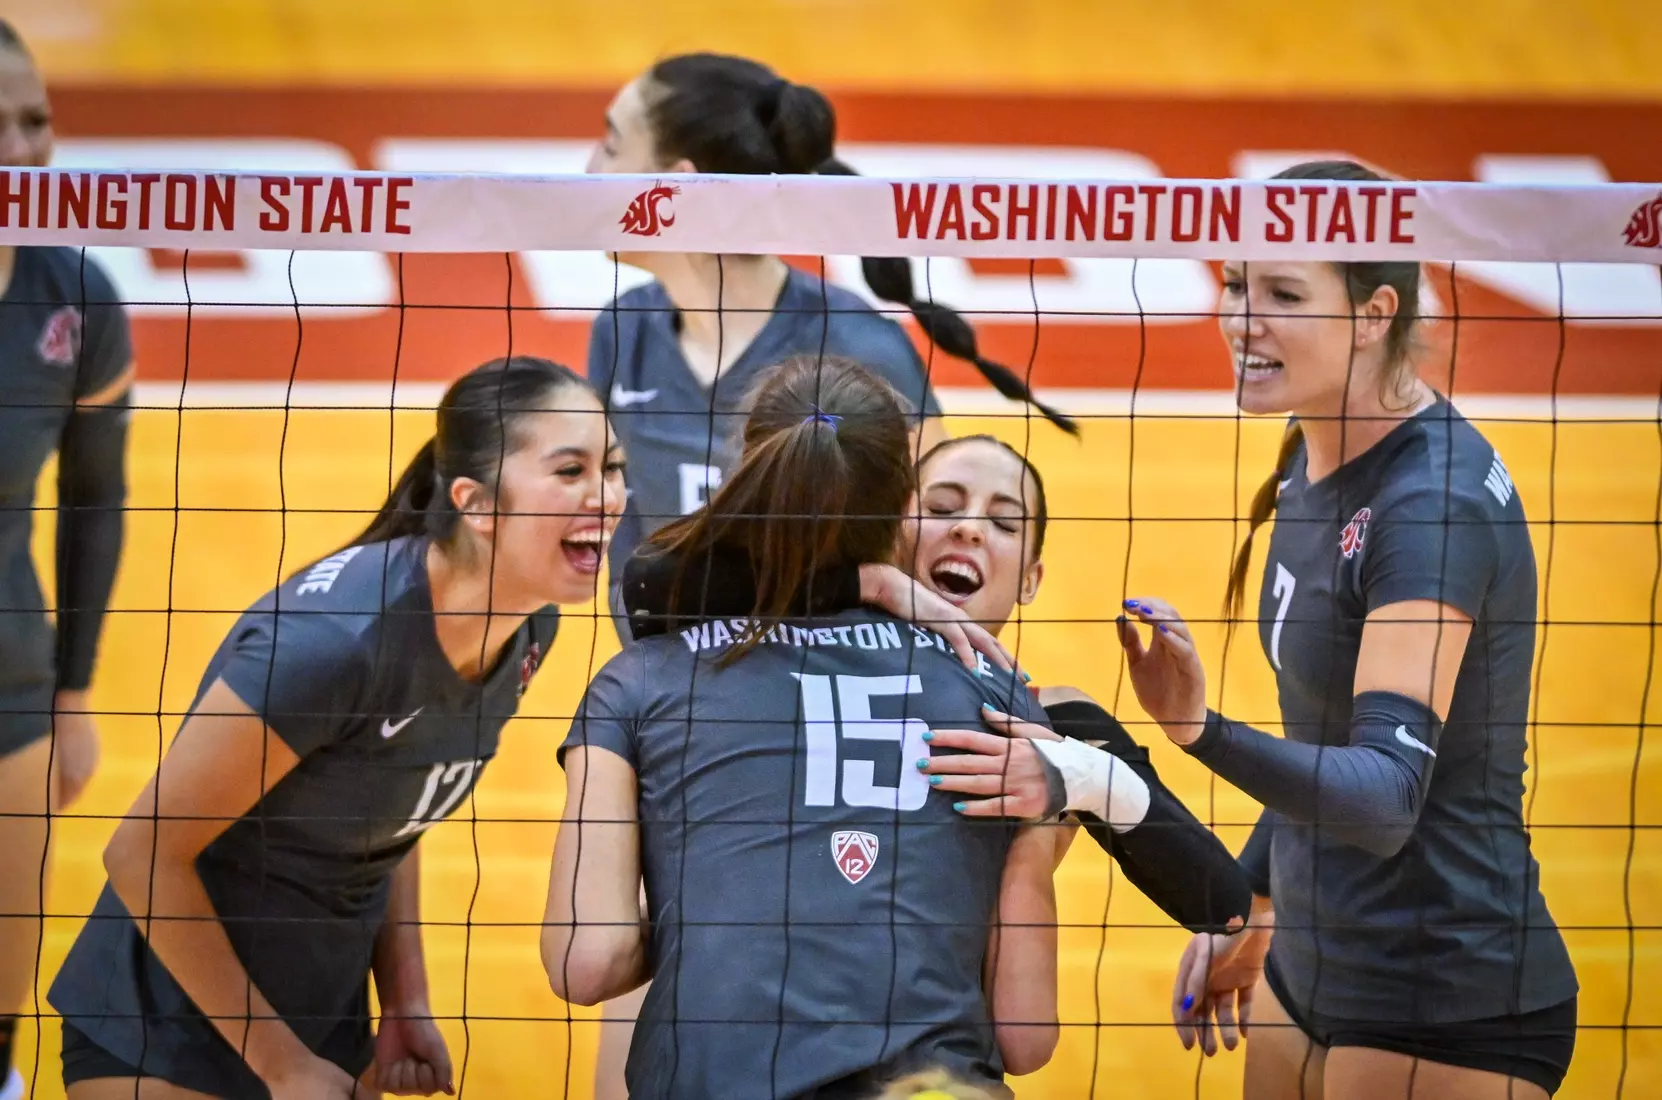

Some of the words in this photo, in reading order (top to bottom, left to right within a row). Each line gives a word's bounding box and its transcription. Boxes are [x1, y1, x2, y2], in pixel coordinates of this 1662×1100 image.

[259, 176, 413, 234] STATE
[891, 183, 1241, 242] WASHINGTON
[1265, 186, 1417, 243] STATE
[1271, 561, 1296, 670] 7
[789, 671, 931, 811] 15
[834, 833, 877, 865] PAC
[845, 858, 865, 875] 12
